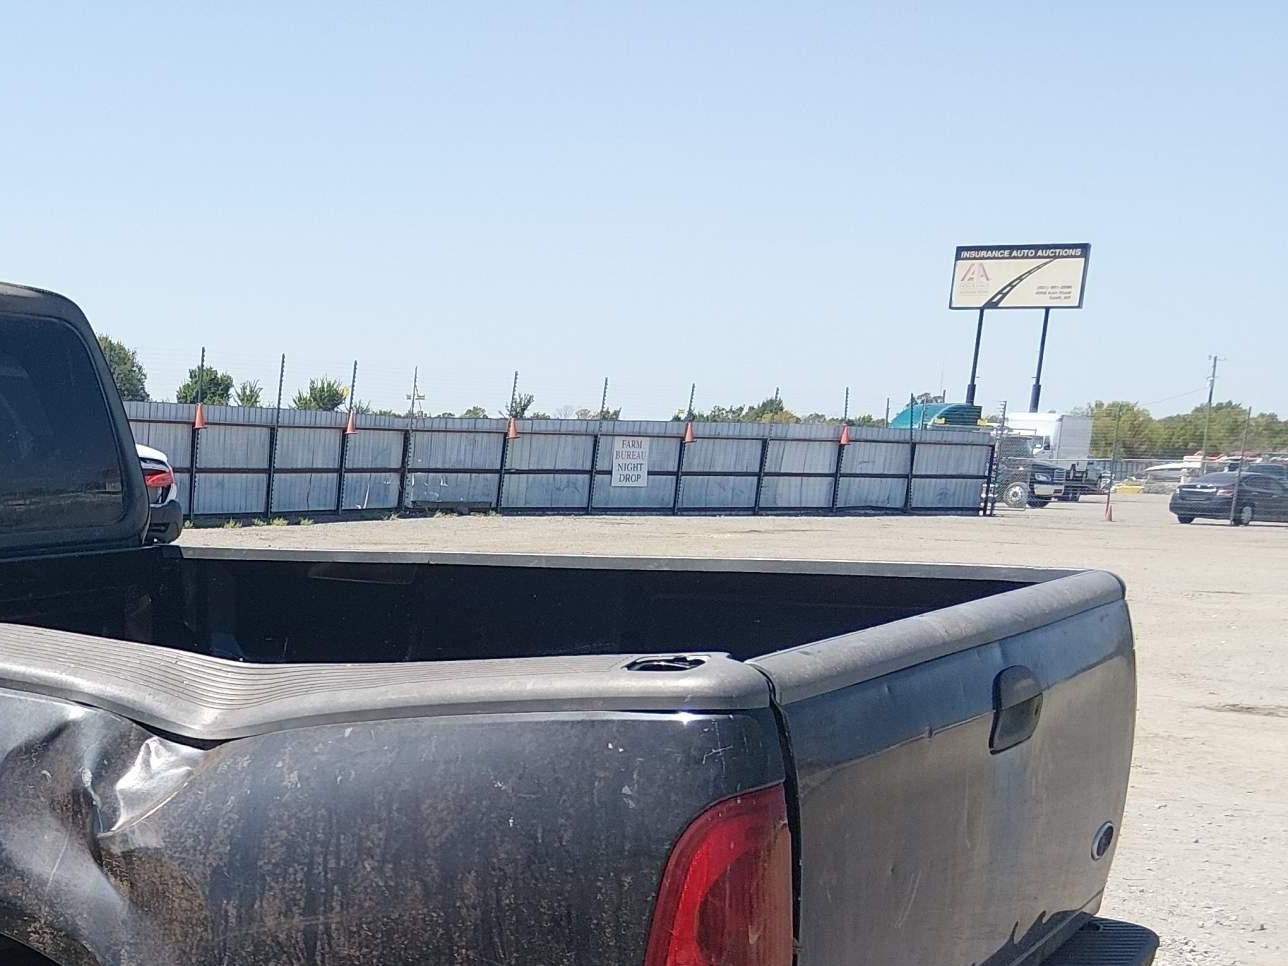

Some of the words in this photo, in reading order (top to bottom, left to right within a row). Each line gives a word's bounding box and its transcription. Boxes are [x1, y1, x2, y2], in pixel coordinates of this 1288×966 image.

[960, 249, 1011, 258] INSURANCE
[1011, 249, 1035, 258] AUTO
[1037, 248, 1082, 257] AUCTIONS
[621, 439, 643, 449] FARM
[615, 450, 647, 460] BUREAU
[617, 462, 644, 472] NIGHT
[618, 473, 642, 483] DROP
